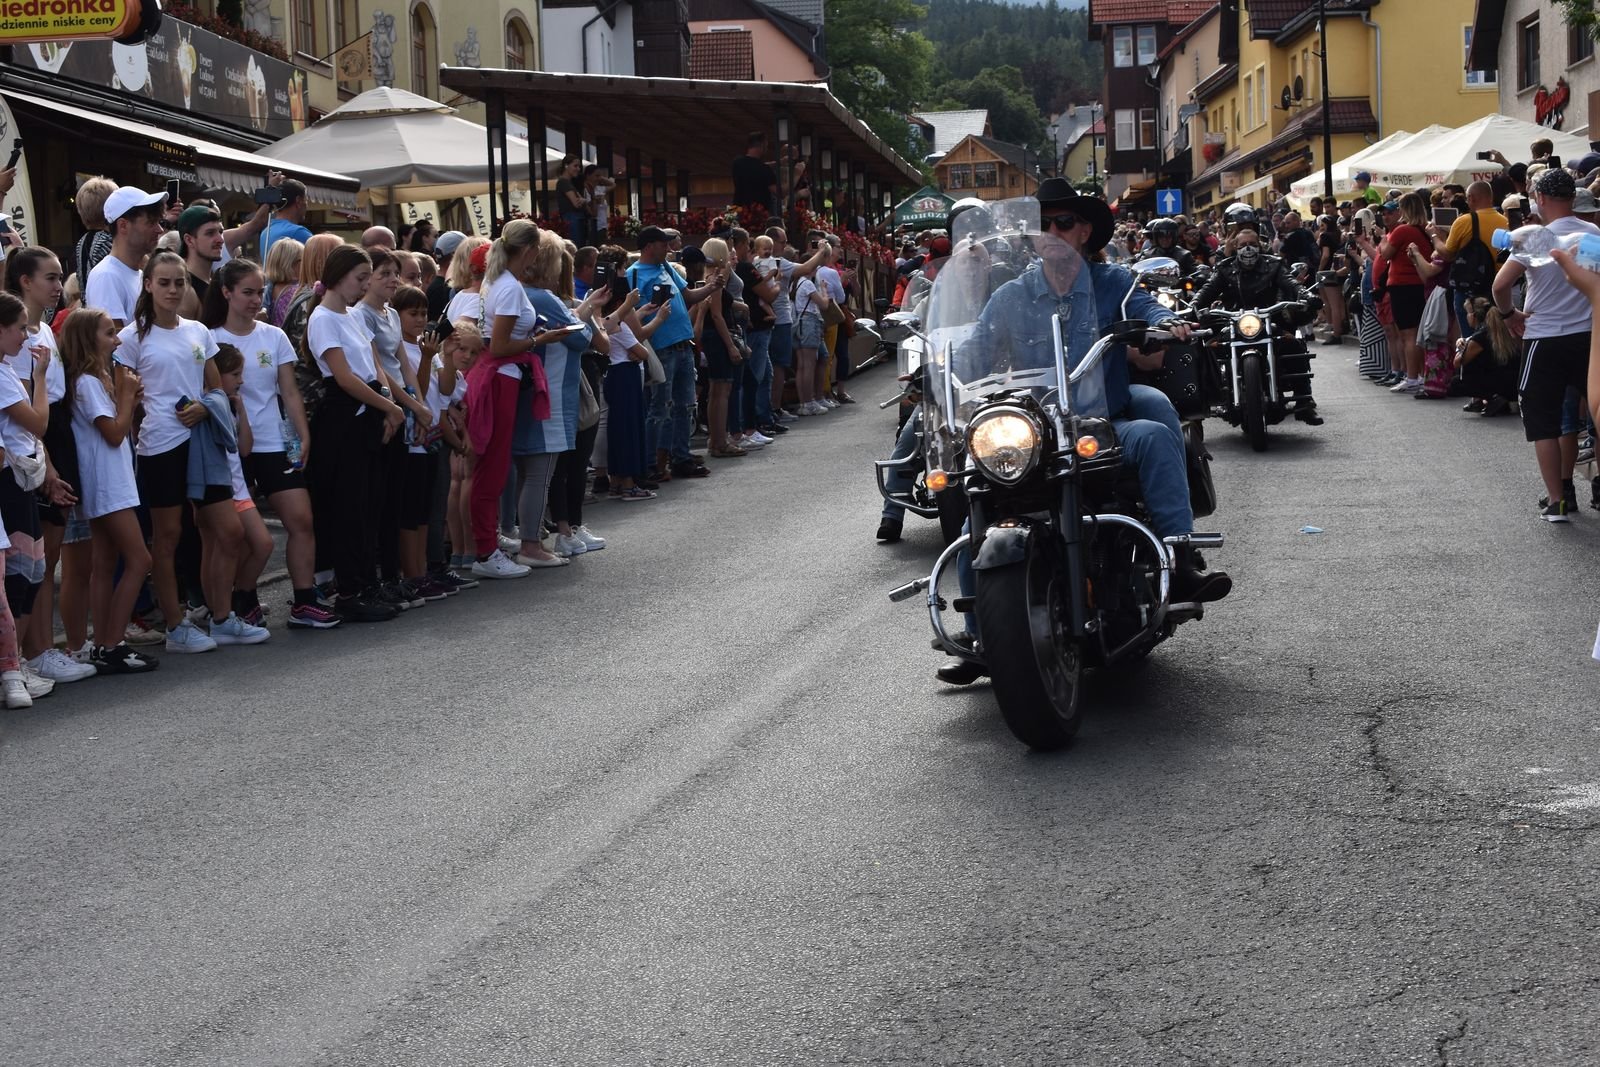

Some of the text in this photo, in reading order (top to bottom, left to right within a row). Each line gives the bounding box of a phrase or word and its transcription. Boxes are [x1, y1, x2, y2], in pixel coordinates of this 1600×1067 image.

[0, 0, 115, 17] iedronka
[0, 16, 116, 30] dziennie niskie ceny
[147, 163, 159, 174] TOP
[1388, 174, 1413, 186] VERDE
[1471, 172, 1504, 182] TYSK
